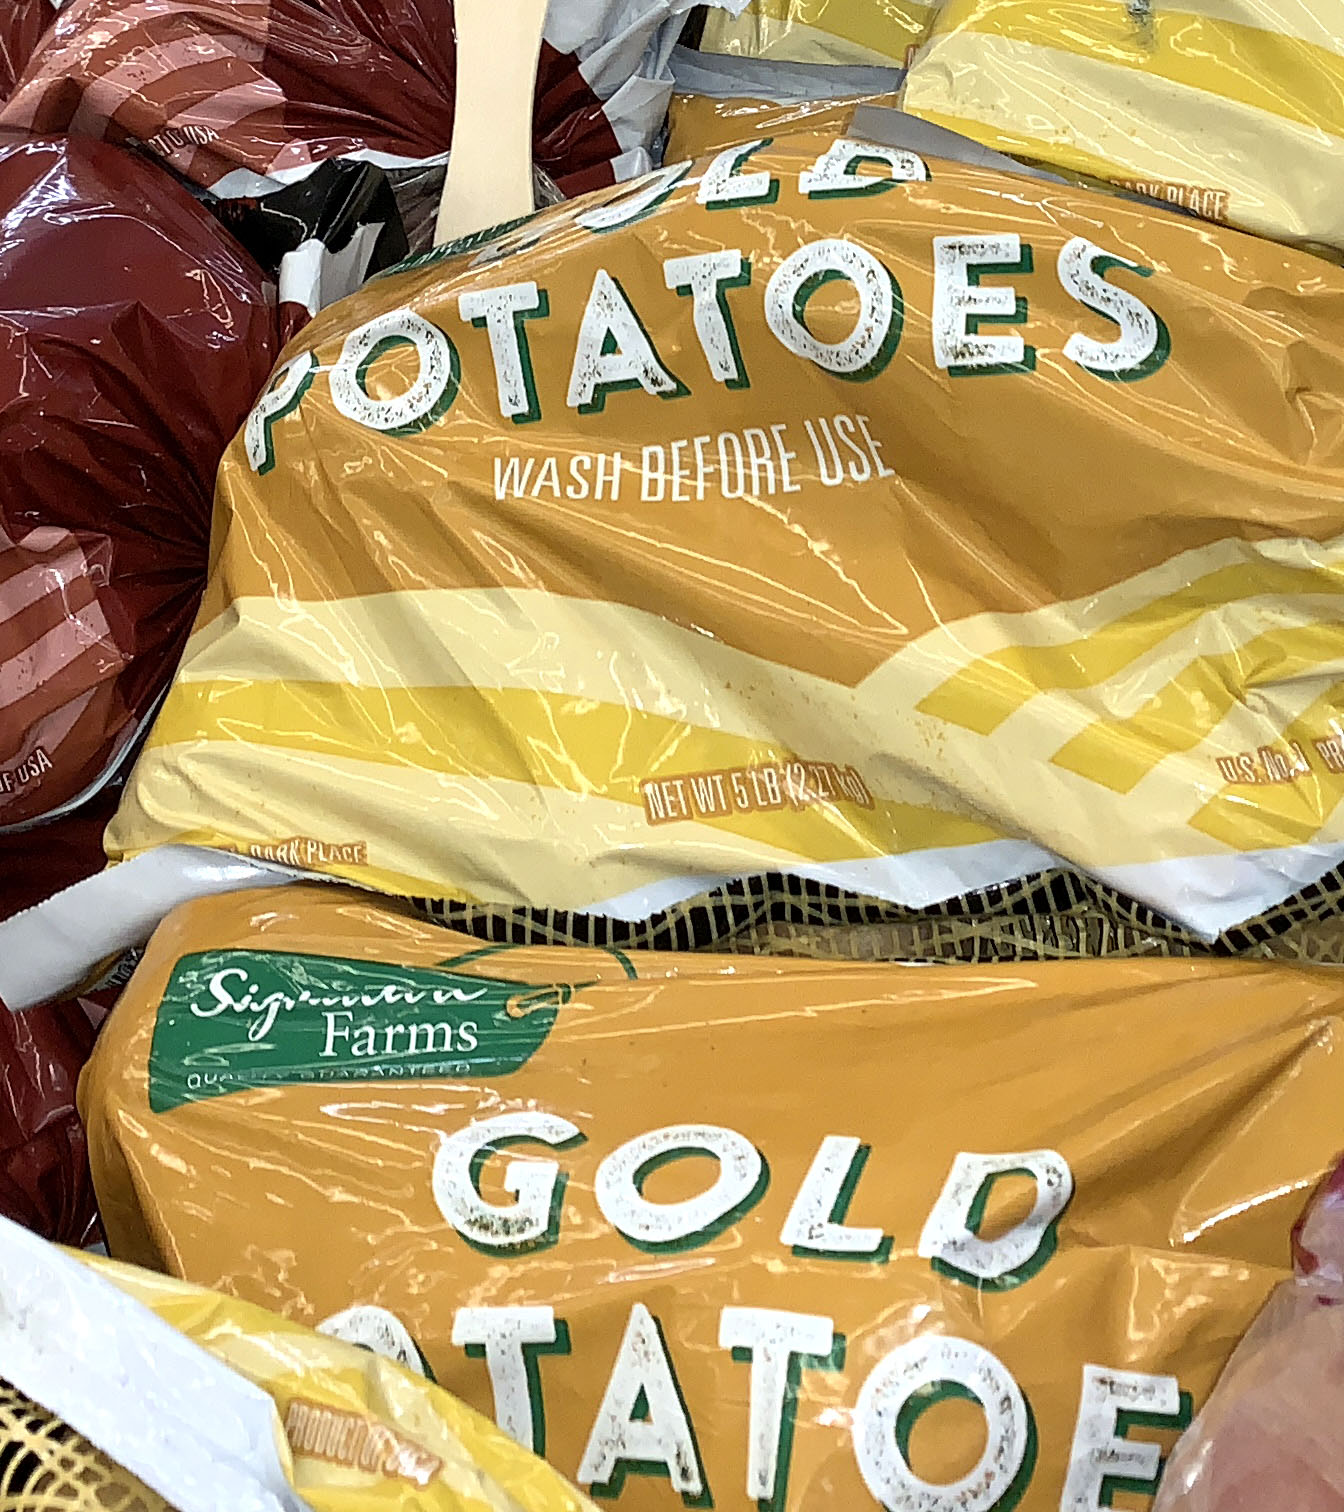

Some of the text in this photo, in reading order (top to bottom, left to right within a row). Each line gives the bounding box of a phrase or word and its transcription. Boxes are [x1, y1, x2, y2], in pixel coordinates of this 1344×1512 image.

[244, 231, 1161, 473] POTATOES
[493, 413, 895, 505] WASH BEFORE USE
[17, 748, 54, 784] USA
[644, 779, 688, 820] NET
[690, 774, 728, 814] WT
[731, 772, 749, 809] 5
[750, 766, 782, 807] LB
[318, 1009, 479, 1058] Farms
[432, 1111, 1073, 1282] GOLD
